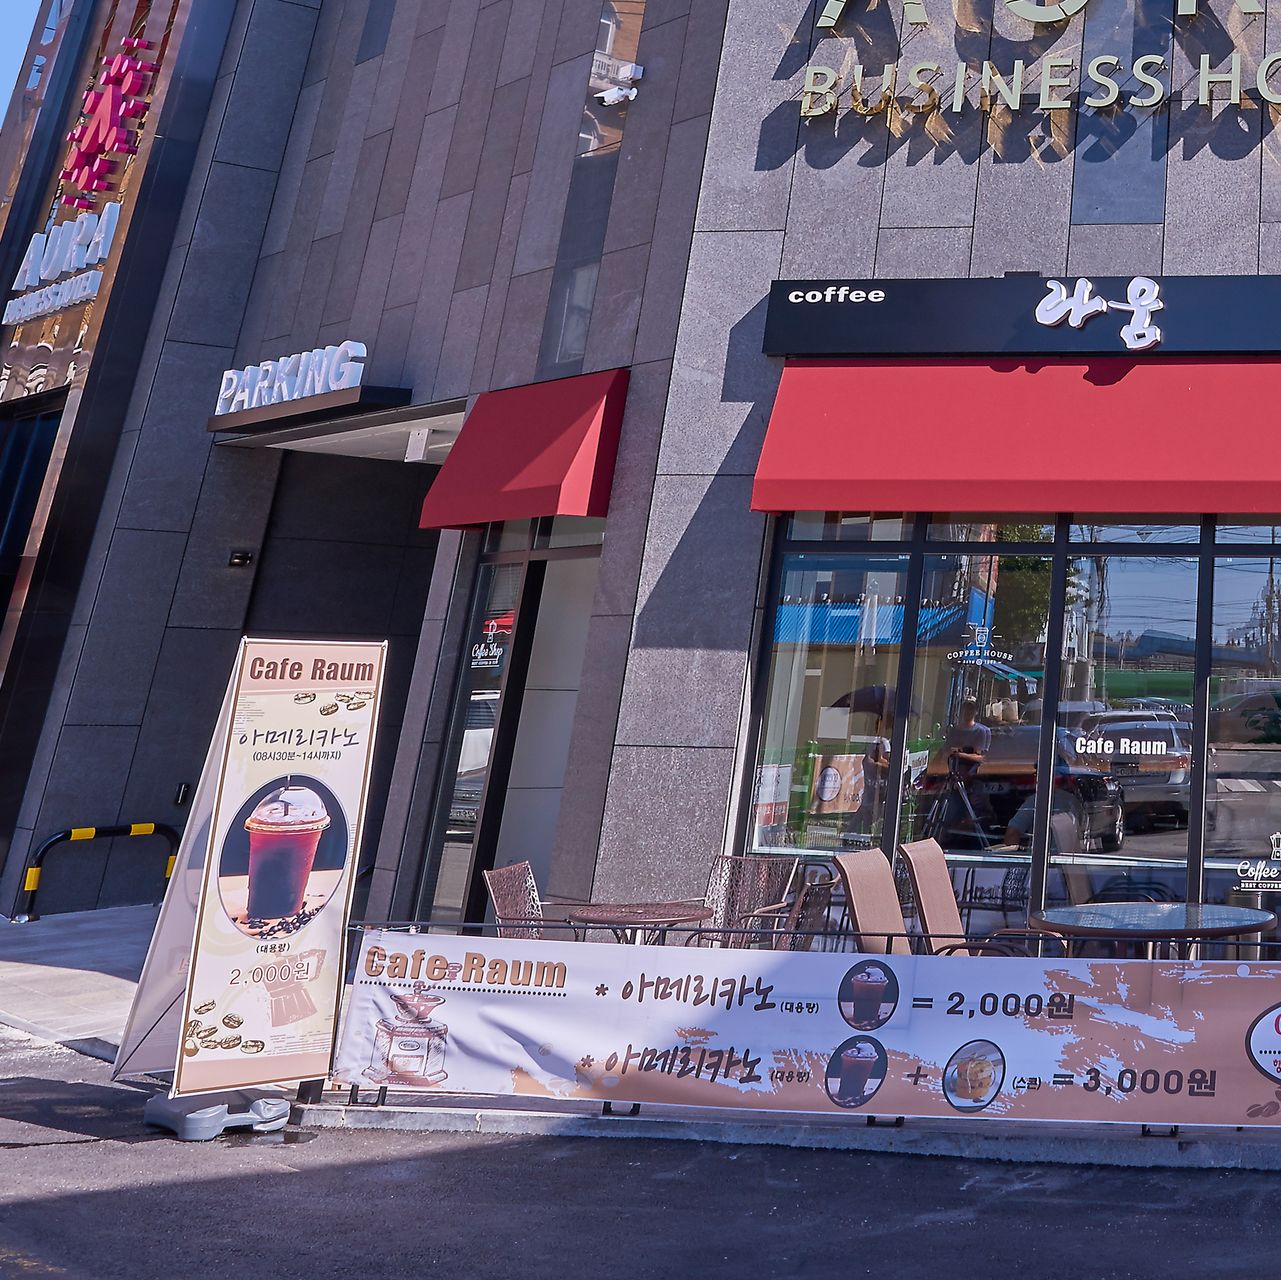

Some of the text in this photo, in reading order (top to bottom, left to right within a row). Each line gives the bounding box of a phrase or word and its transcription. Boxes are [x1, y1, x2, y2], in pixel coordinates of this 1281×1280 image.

[800, 54, 1165, 117] BUSINESS
[11, 202, 121, 291] AURA
[788, 286, 886, 303] coffee
[1035, 277, 1164, 351] 라움
[214, 340, 368, 416] PARKING
[947, 650, 1014, 660] COFFEE HOUSE
[249, 657, 375, 681] Cafe Raum
[238, 727, 360, 748] 아메리카노
[1075, 737, 1167, 755] Cafe Raum
[252, 751, 342, 762] (08시30분~14시까지)
[1237, 860, 1280, 882] Coffee
[256, 943, 291, 954] (대용량)
[229, 961, 310, 985] 2.000원
[365, 945, 567, 989] Cafe Raum
[621, 972, 776, 1011] 아메리카노
[780, 1002, 820, 1014] (대용량)
[946, 991, 1075, 1020] 2,000원
[604, 1043, 762, 1084] 아메리카노
[1012, 1076, 1042, 1090] (스콘)
[1083, 1068, 1217, 1097] 3,000원
